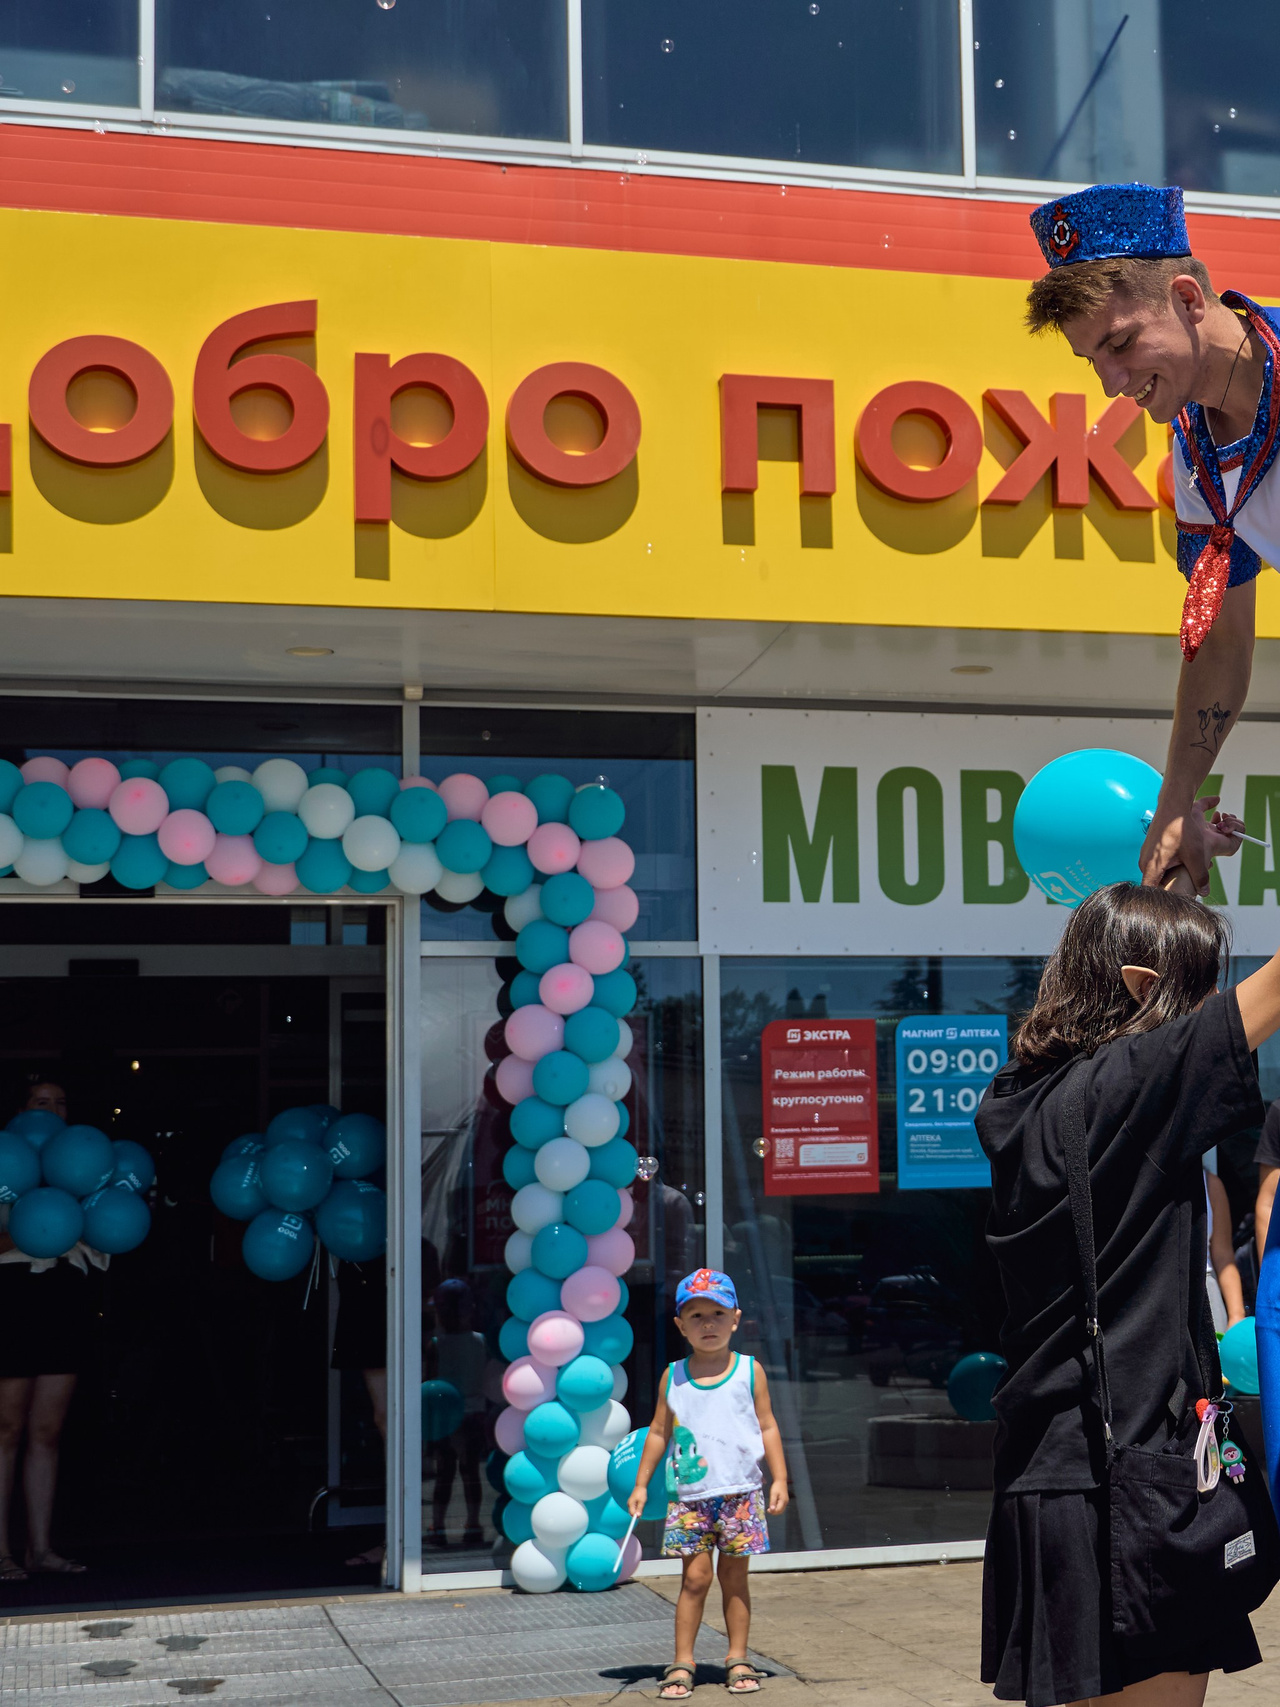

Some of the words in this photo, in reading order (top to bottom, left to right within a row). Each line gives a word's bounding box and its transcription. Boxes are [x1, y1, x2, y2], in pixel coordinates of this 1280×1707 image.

[0, 299, 642, 524] обро
[803, 1030, 851, 1040] ЭКСТРА
[902, 1029, 944, 1038] МАГНИТ
[959, 1028, 1001, 1038] АПТЕКА
[907, 1049, 999, 1074] 09:00
[774, 1069, 814, 1079] Режим
[817, 1068, 865, 1080] работы:
[772, 1095, 864, 1107] круглосуточно
